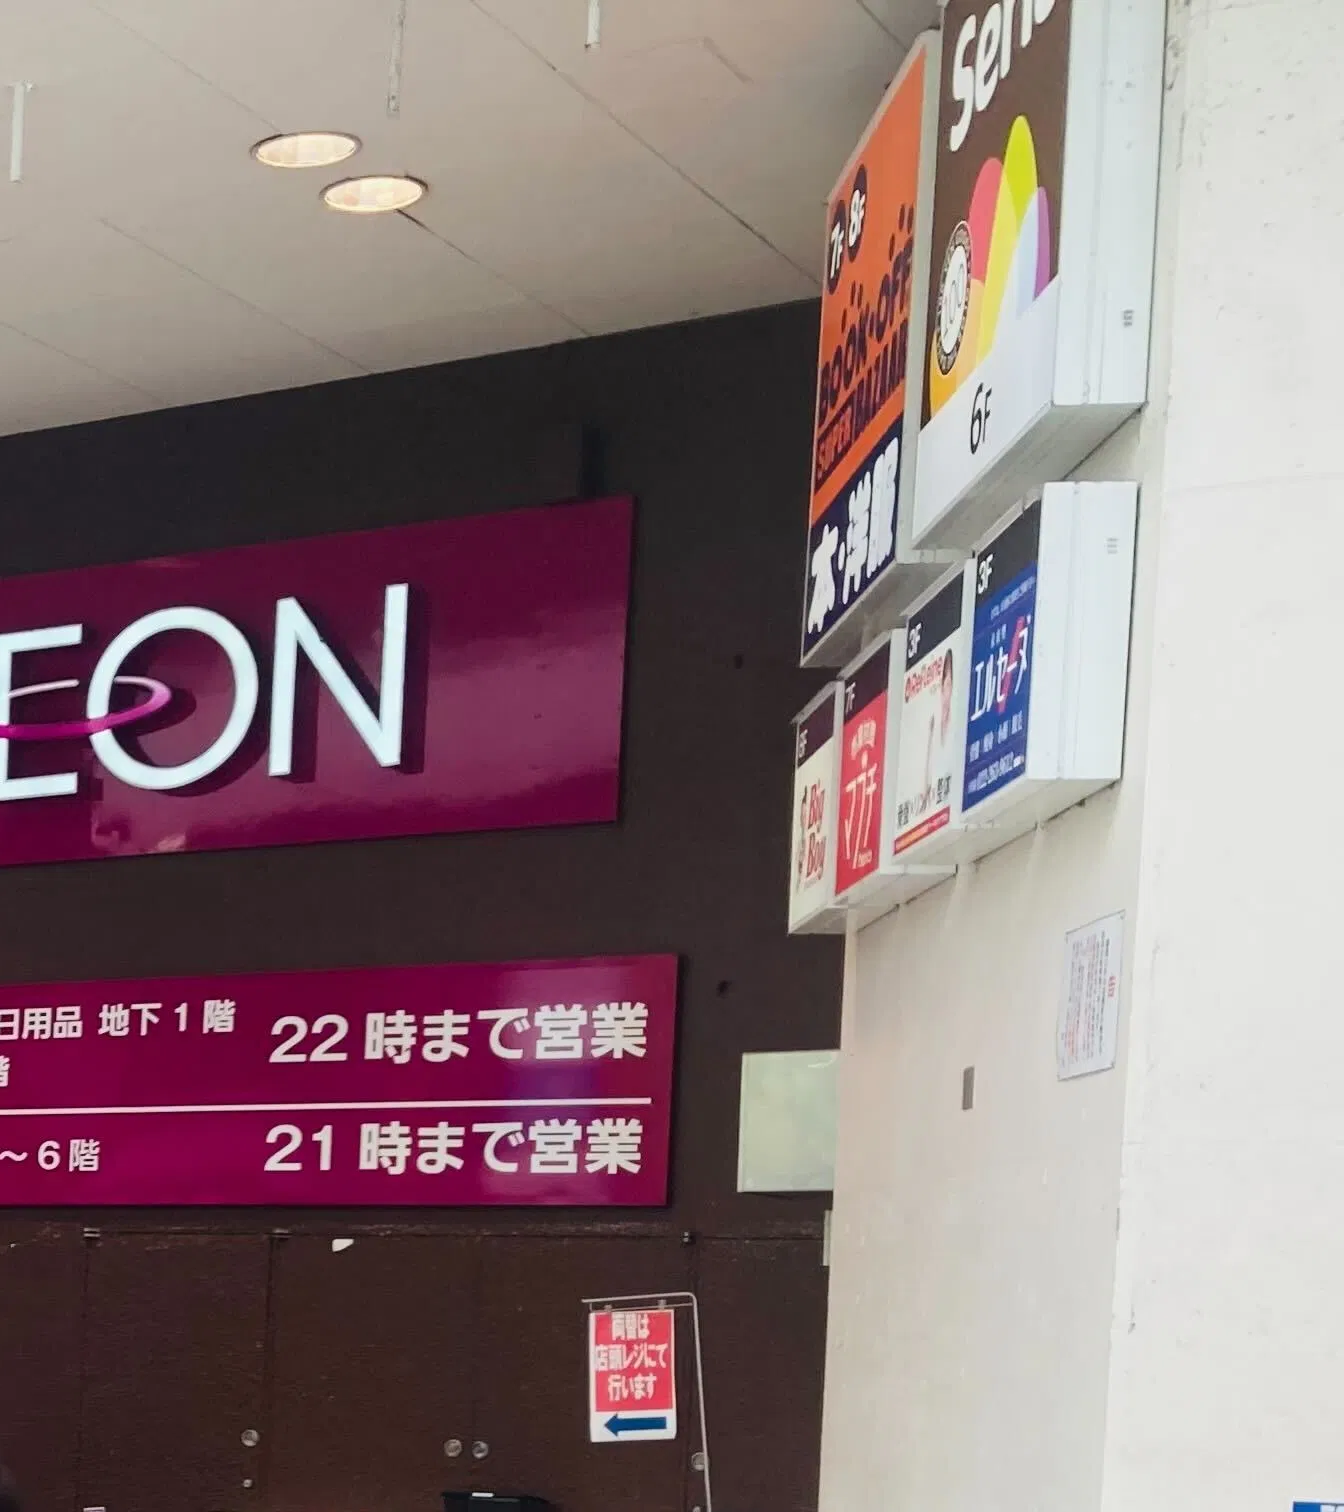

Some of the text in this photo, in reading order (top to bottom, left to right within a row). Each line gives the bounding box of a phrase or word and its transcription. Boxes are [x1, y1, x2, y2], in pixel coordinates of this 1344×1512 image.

[949, 0, 1056, 152] Ser
[830, 190, 865, 279] 7F 8F
[970, 382, 992, 454] 6F
[978, 554, 993, 594] 3F
[99, 999, 236, 1037] 地下1階
[269, 1002, 649, 1064] 22時まで営業
[264, 1118, 643, 1176] 21時まで営業
